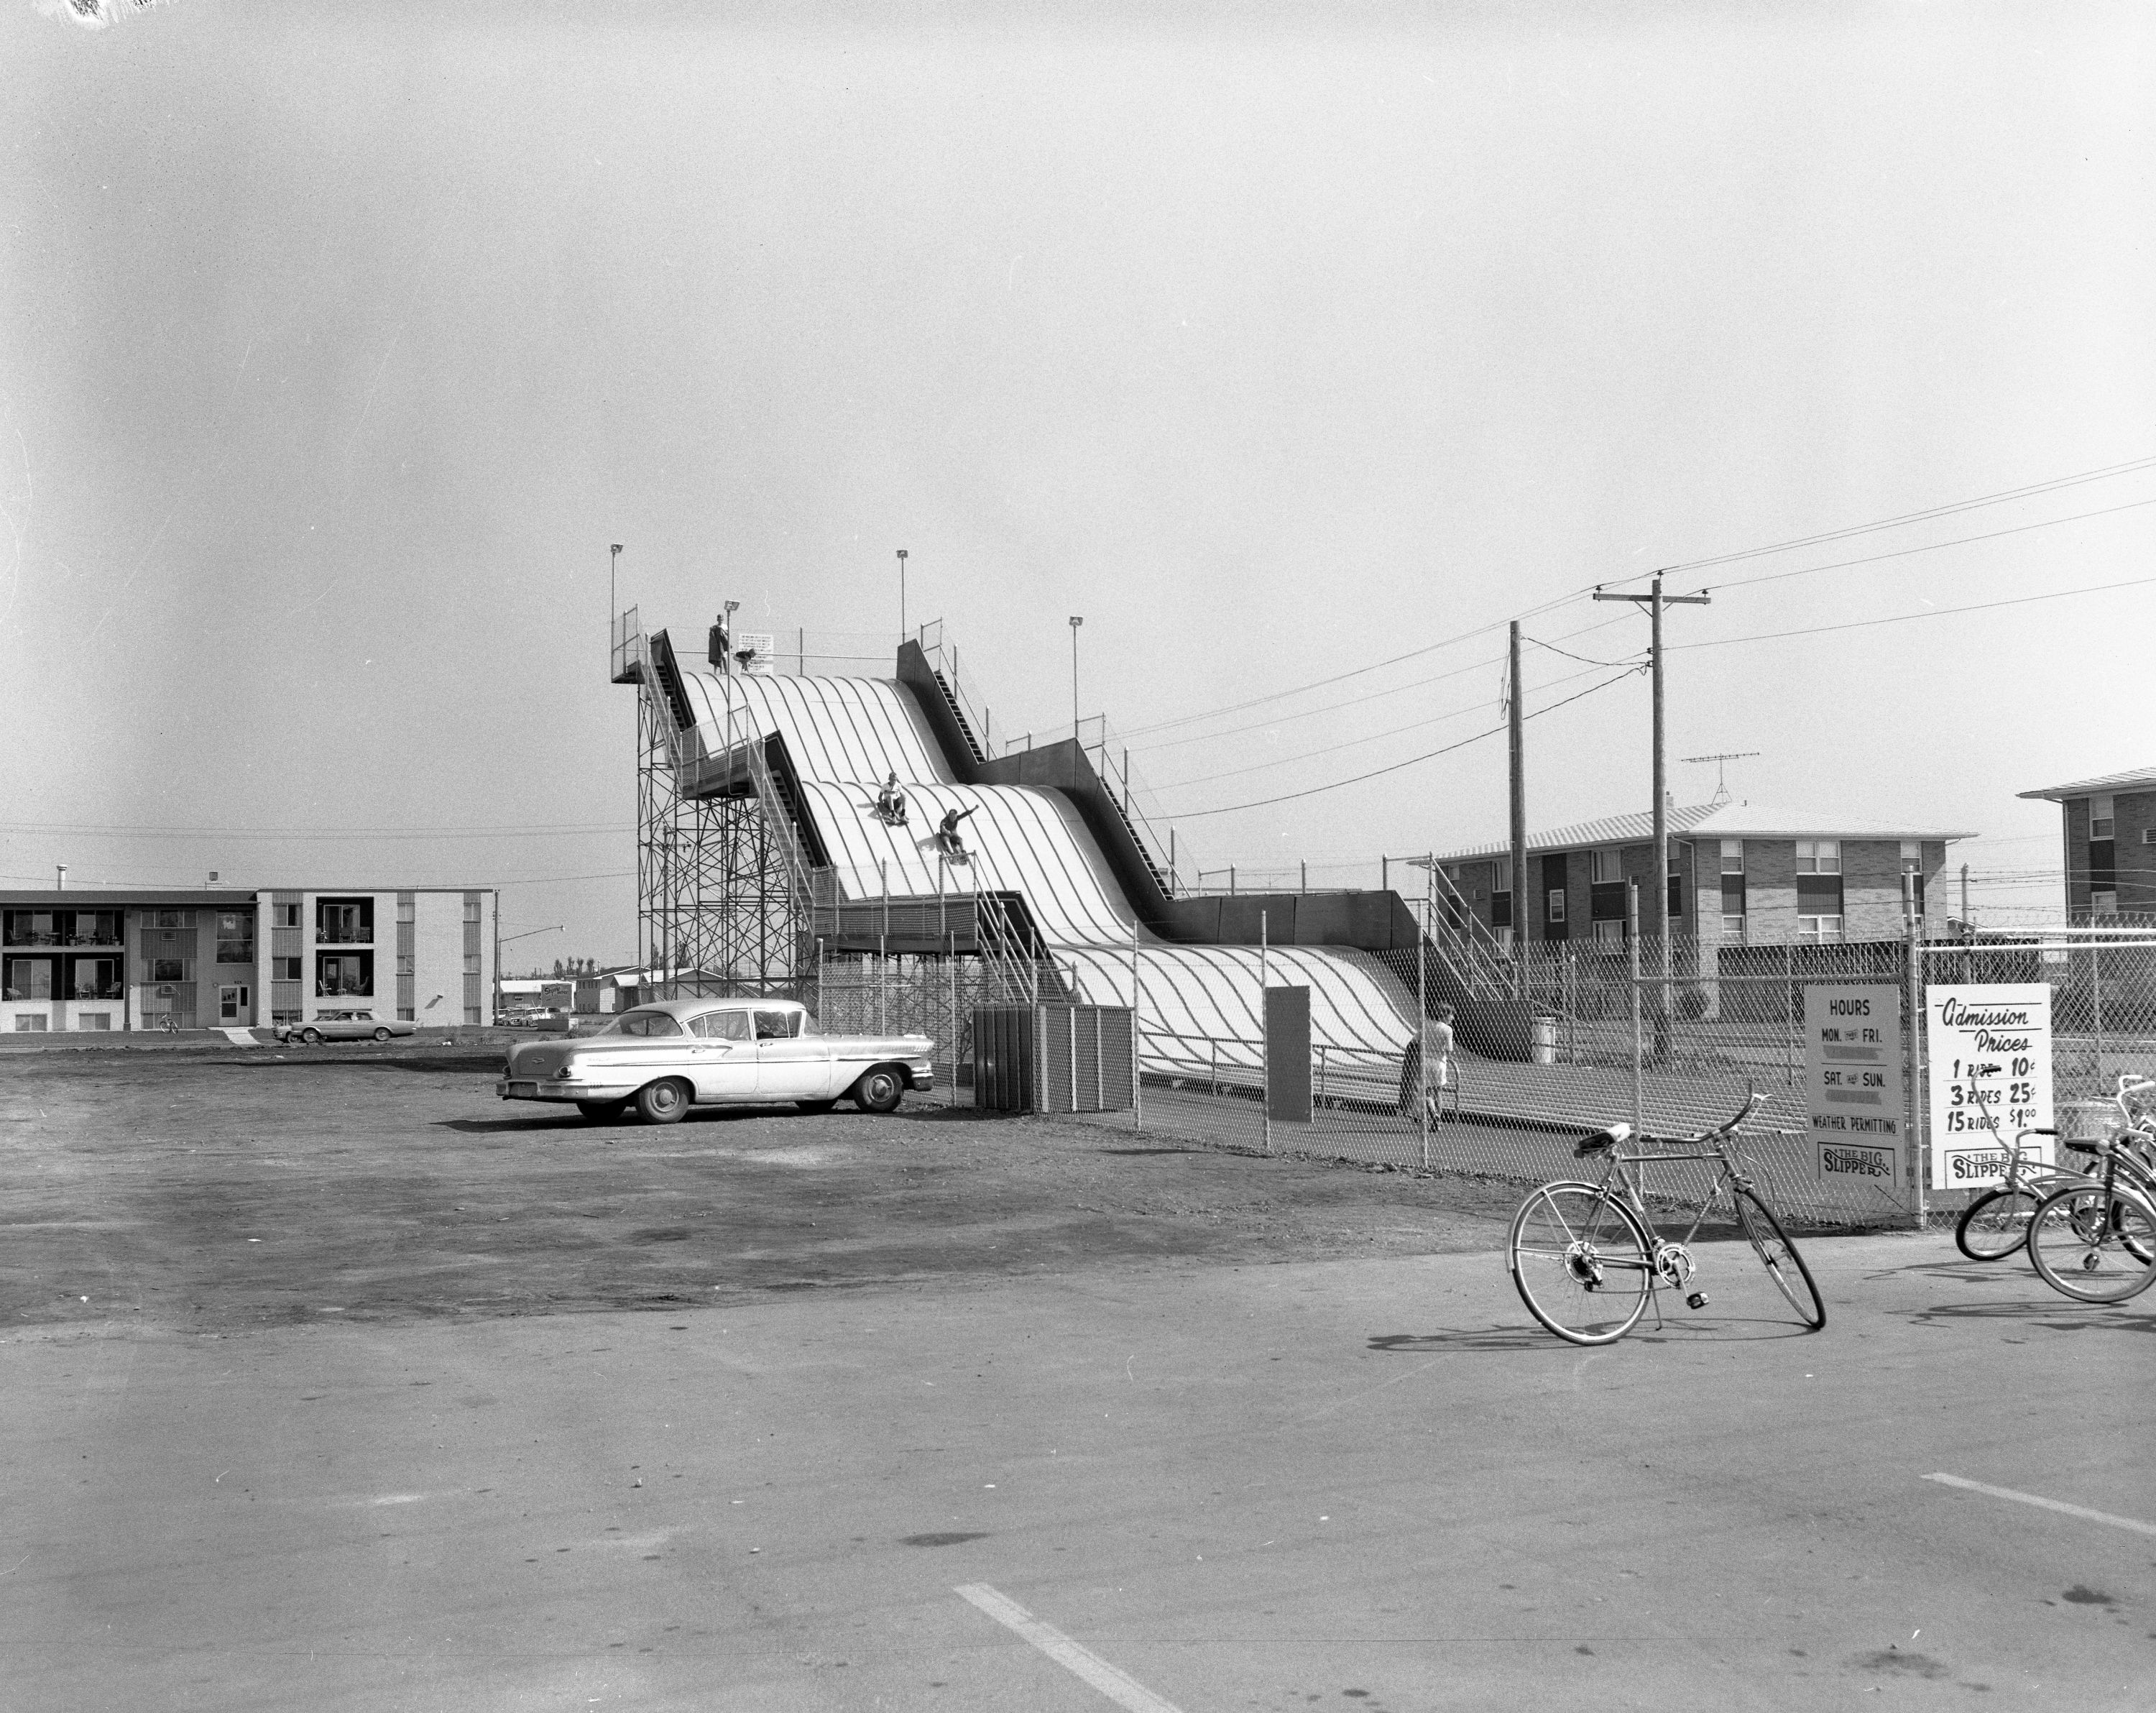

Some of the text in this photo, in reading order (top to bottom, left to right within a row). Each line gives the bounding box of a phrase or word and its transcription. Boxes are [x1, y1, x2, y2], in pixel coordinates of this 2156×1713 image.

[1830, 999, 1870, 1016] HOURS
[1943, 997, 2029, 1027] Admission
[1822, 1028, 1842, 1042] MON.
[1863, 1029, 1882, 1043] FRI.
[1975, 1029, 2033, 1052] Prices
[1953, 1059, 1961, 1078] 1
[1824, 1071, 1842, 1085] SAT.
[1863, 1073, 1886, 1087] SUN.
[1950, 1085, 1964, 1106] 3
[1812, 1116, 1896, 1134] WEATHER PERMITTING
[1948, 1111, 1965, 1131] 15
[1824, 1152, 1881, 1177] SLIPPER
[1839, 1149, 1882, 1165] THE BIG
[1973, 1151, 2028, 1163] THE BG
[1953, 1158, 2027, 1179] SLIPPE
